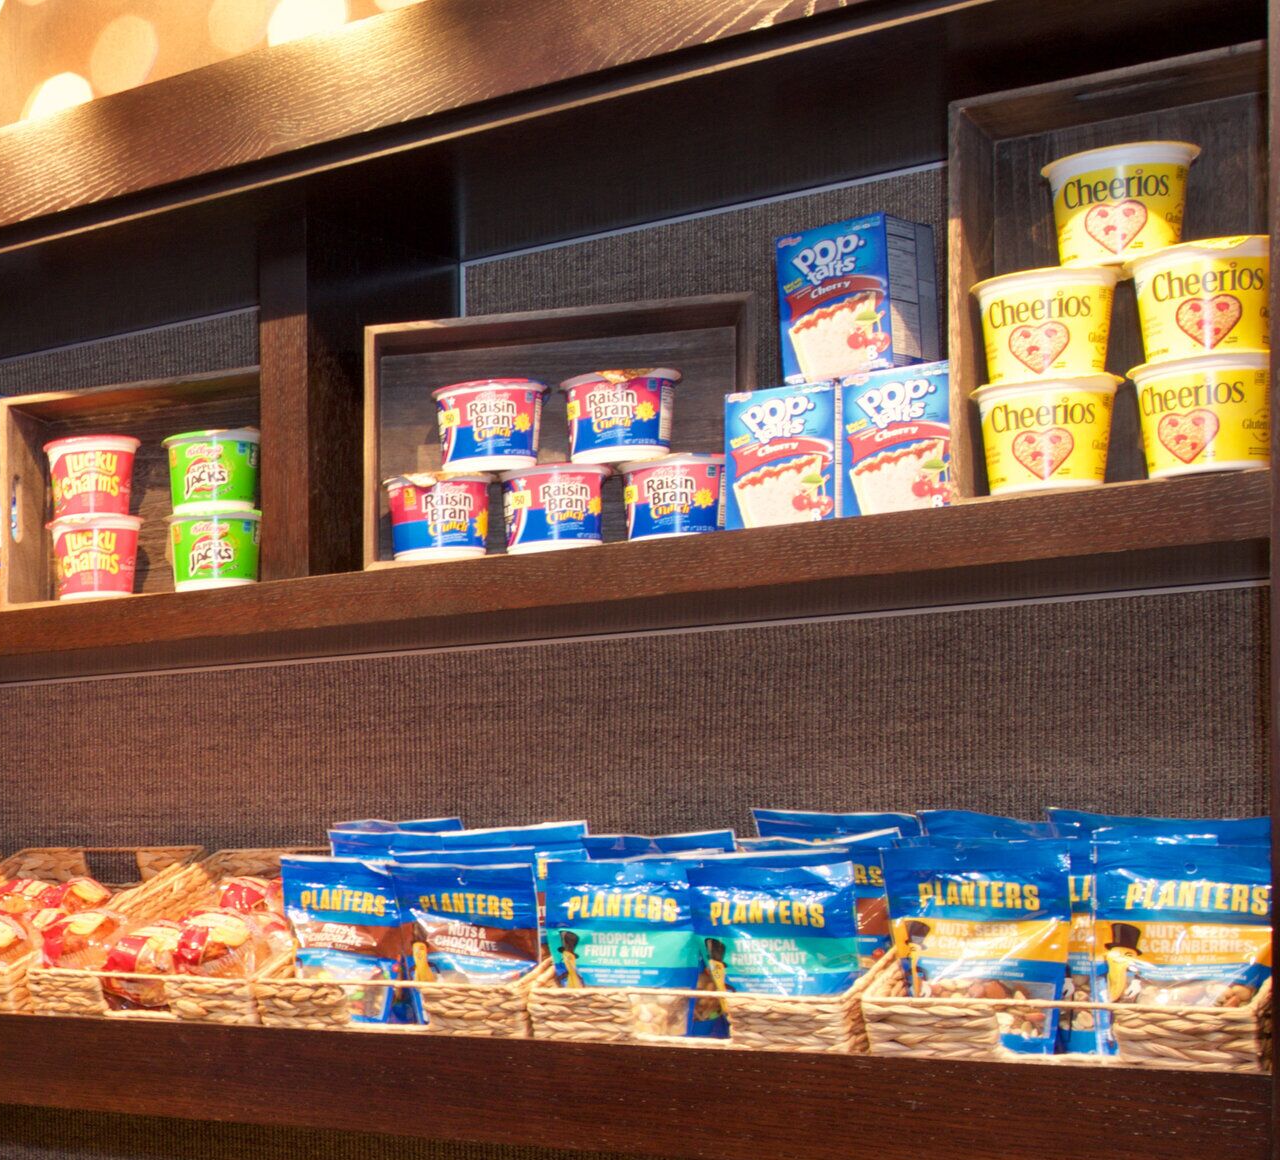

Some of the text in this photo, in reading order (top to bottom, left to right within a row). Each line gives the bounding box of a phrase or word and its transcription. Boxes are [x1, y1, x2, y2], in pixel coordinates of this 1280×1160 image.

[1063, 169, 1170, 210] Cheerios
[810, 280, 851, 299] Cherry
[1152, 262, 1265, 303] Cheerios
[989, 291, 1092, 330] Cheerios
[589, 391, 636, 405] Raisin
[1141, 377, 1246, 417] Cheerios
[469, 403, 515, 415] Raisin
[595, 404, 630, 417] Bran
[991, 397, 1096, 434] Cheerios
[476, 414, 510, 427] Bran
[593, 418, 630, 433] Crunch
[474, 428, 510, 442] Crunch
[874, 425, 919, 442] Cherry
[757, 440, 799, 457] Cherry
[185, 470, 226, 495] JACKS
[646, 477, 694, 492] Raisin
[542, 484, 589, 499] Raisin
[653, 490, 688, 504] Bran
[424, 495, 472, 508] Raisin
[548, 497, 585, 511] Bran
[430, 508, 467, 521] Bran
[546, 510, 584, 524] Crunch
[650, 503, 690, 519] Crunch
[429, 521, 468, 536] Crunch
[191, 548, 232, 572] JACKS
[301, 889, 386, 917] PLANTERS
[918, 880, 1040, 911] PLANTERS
[1125, 880, 1269, 916] PLANTERS
[419, 893, 514, 920] PLANTERS
[567, 894, 678, 923] PLANTERS
[710, 900, 825, 929] PLANTERS
[435, 935, 498, 952] CHOCOLATE
[592, 932, 648, 945] TROPICAL
[584, 945, 617, 958] FRUIT
[630, 946, 655, 958] NUT
[779, 951, 807, 965] NUT
